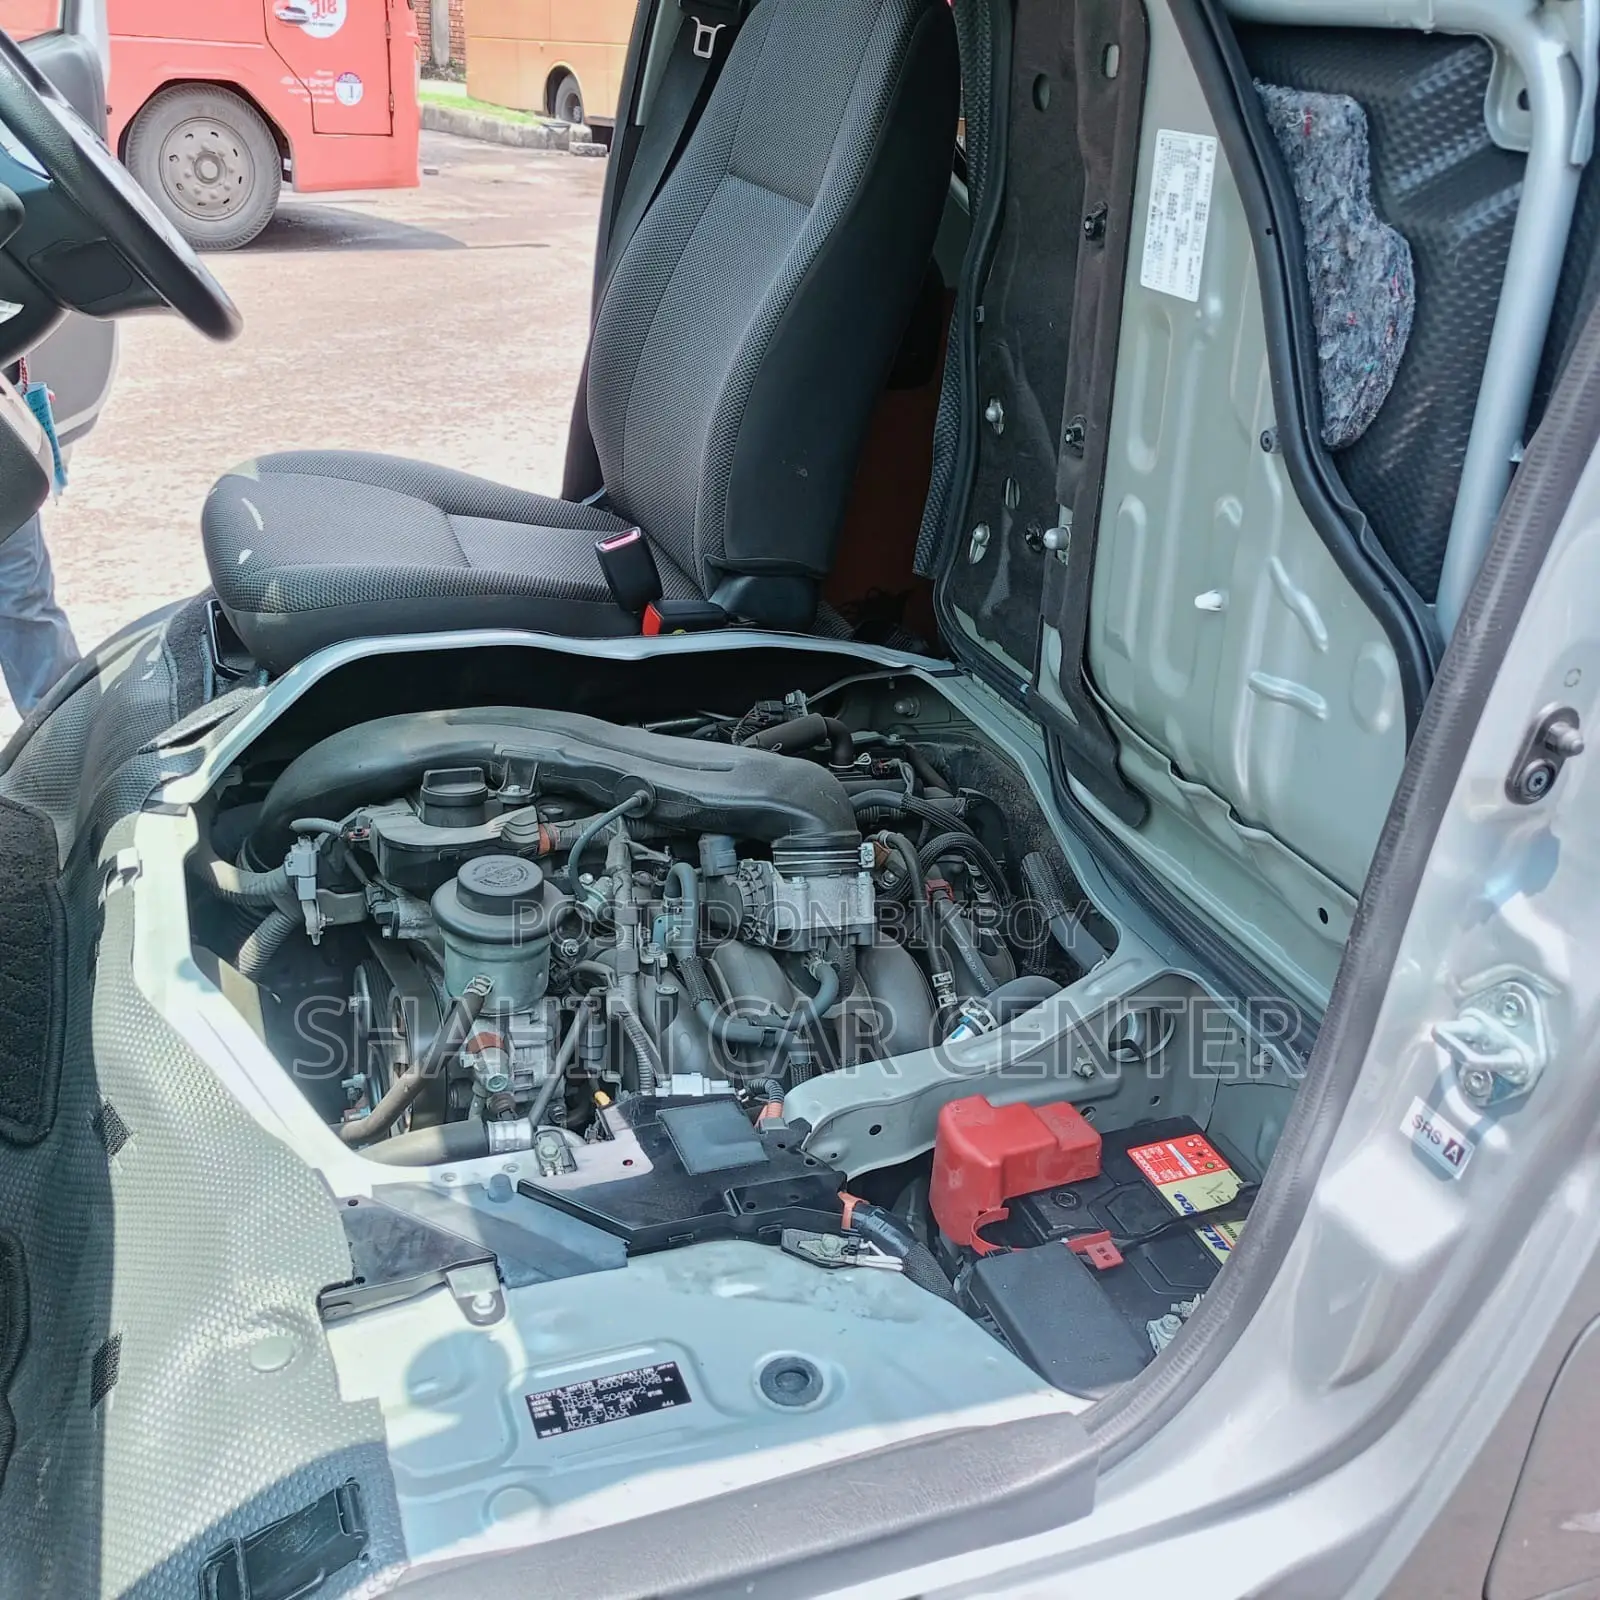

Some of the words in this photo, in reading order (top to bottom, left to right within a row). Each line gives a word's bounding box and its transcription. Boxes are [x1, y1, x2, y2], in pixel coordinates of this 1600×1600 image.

[1411, 1114, 1442, 1145] SRS
[528, 1388, 564, 1401] TOYOTA
[566, 1380, 594, 1392] MOTOR
[597, 1367, 655, 1386] CORPORATION
